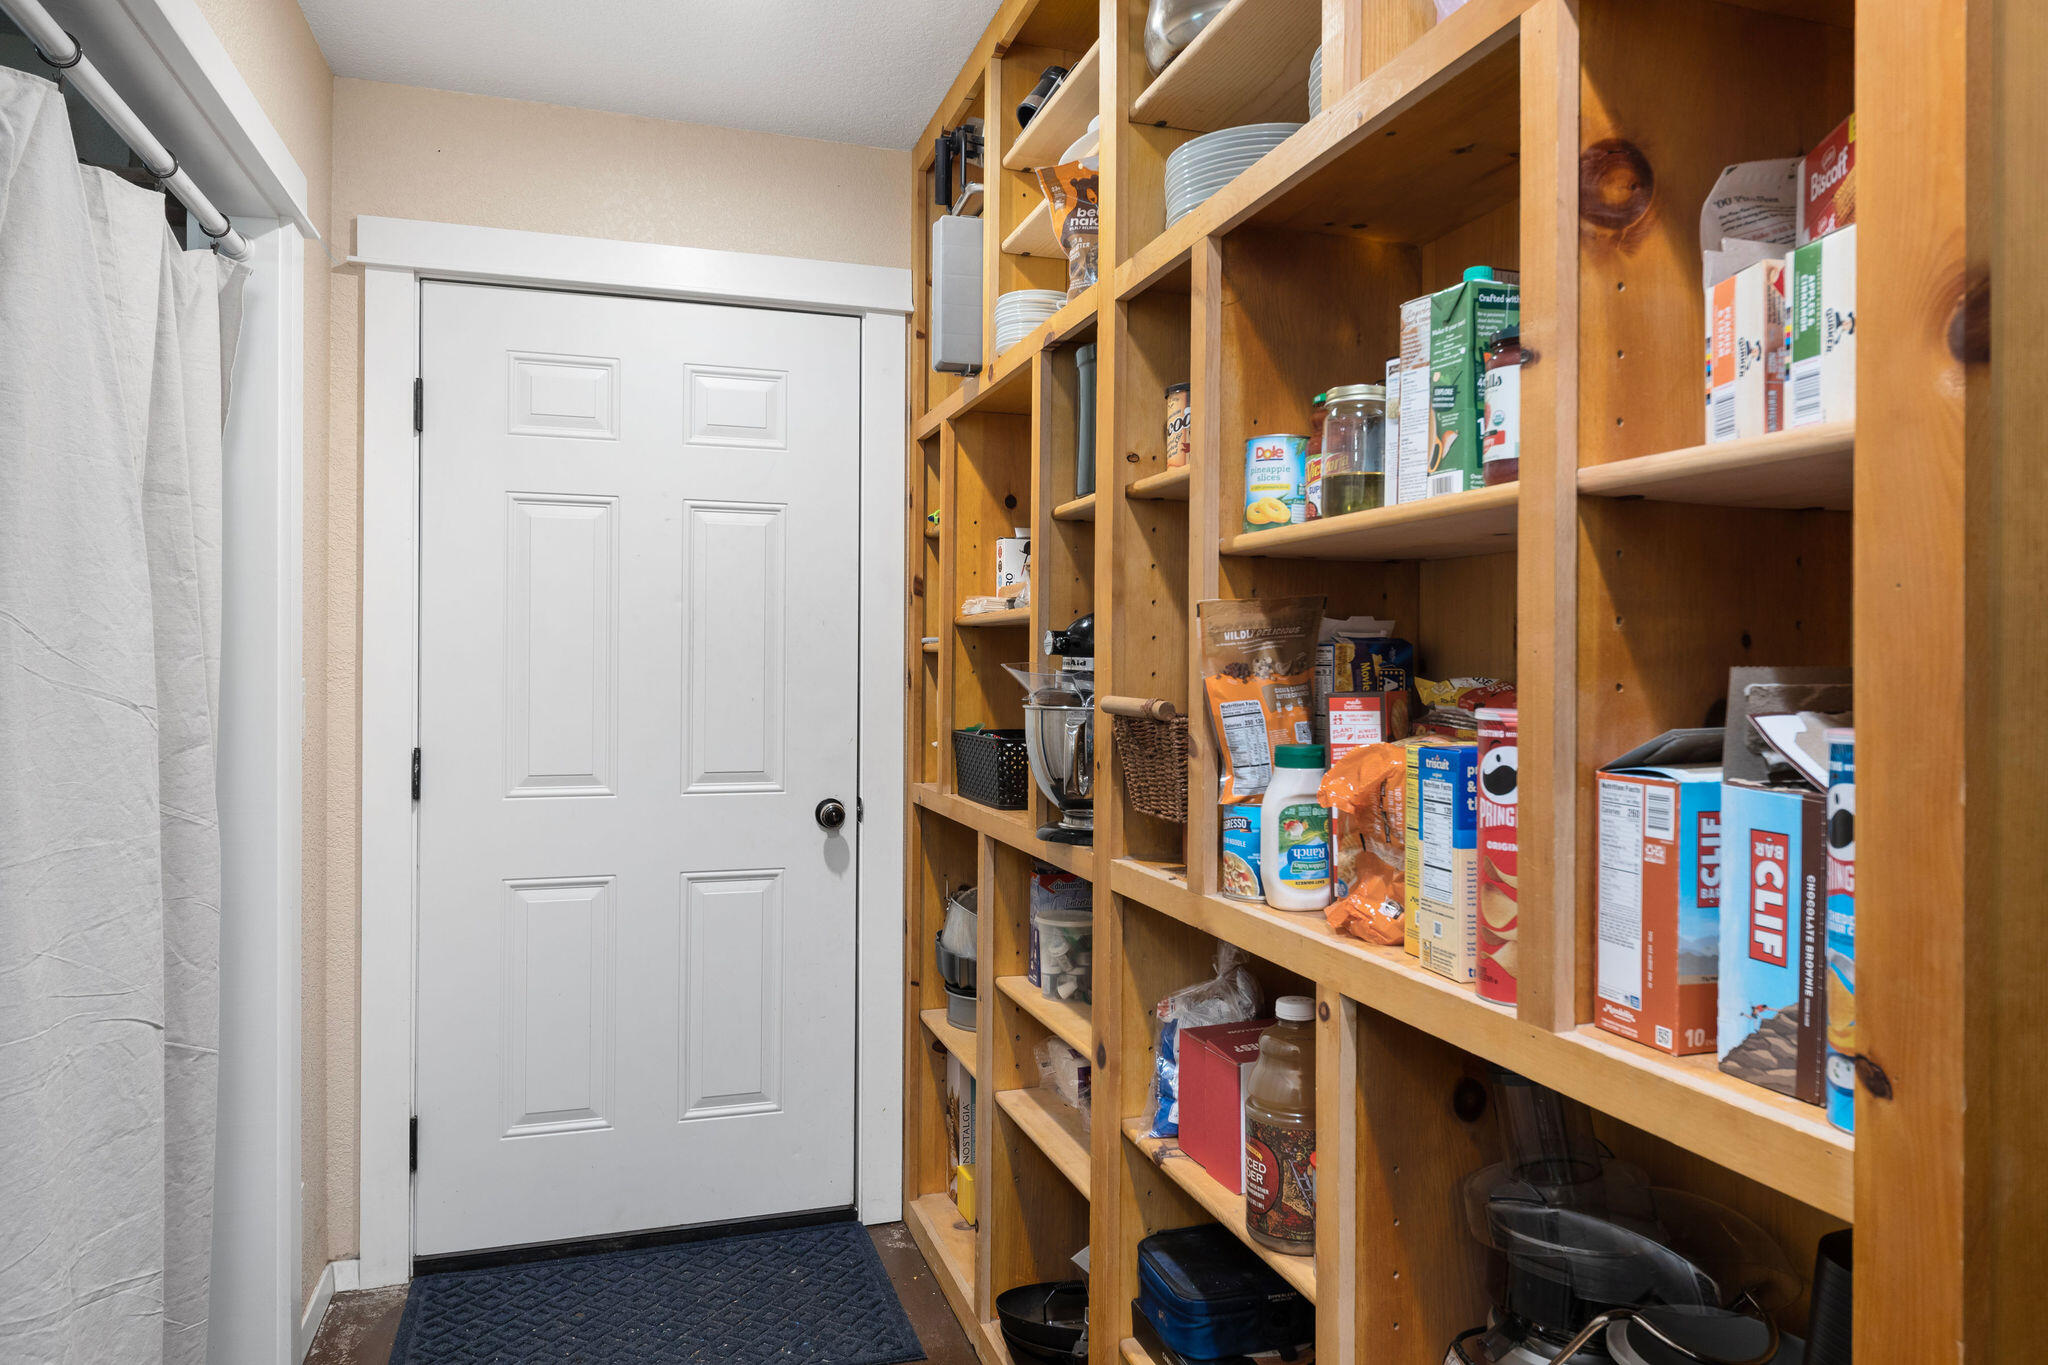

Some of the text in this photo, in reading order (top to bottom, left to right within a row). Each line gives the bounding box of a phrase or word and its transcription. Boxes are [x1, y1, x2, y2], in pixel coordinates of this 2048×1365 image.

[1810, 145, 1848, 202] Biscoff
[1076, 207, 1099, 218] be
[1479, 293, 1504, 302] Crafted
[1799, 273, 1808, 332] CINNAMON
[1808, 274, 1816, 316] APPLES
[1826, 307, 1834, 353] QUAKER
[1256, 445, 1284, 460] Dole
[1250, 466, 1291, 476] pineapple
[1307, 454, 1349, 482] Vicoria
[1257, 473, 1281, 482] slices
[1224, 626, 1302, 640] WILDLY DELICIOUS
[1360, 661, 1372, 692] Movie
[1332, 727, 1353, 735] PLANT
[1425, 756, 1449, 771] triscuit
[1423, 780, 1452, 791] Nutrition Facts
[1467, 780, 1477, 793] &
[1602, 782, 1641, 793] Nutrition Facts
[1701, 817, 1720, 887] CLIF
[1754, 841, 1784, 860] BAR
[1293, 861, 1326, 871] Hidden Valley
[1054, 881, 1085, 890] diamond
[1754, 860, 1784, 959] CLIF
[1805, 874, 1816, 943] CHOCOLATE
[1804, 944, 1815, 998] BROWNIE
[1684, 1028, 1705, 1047] 10
[962, 1103, 970, 1164] NOSTALGIA
